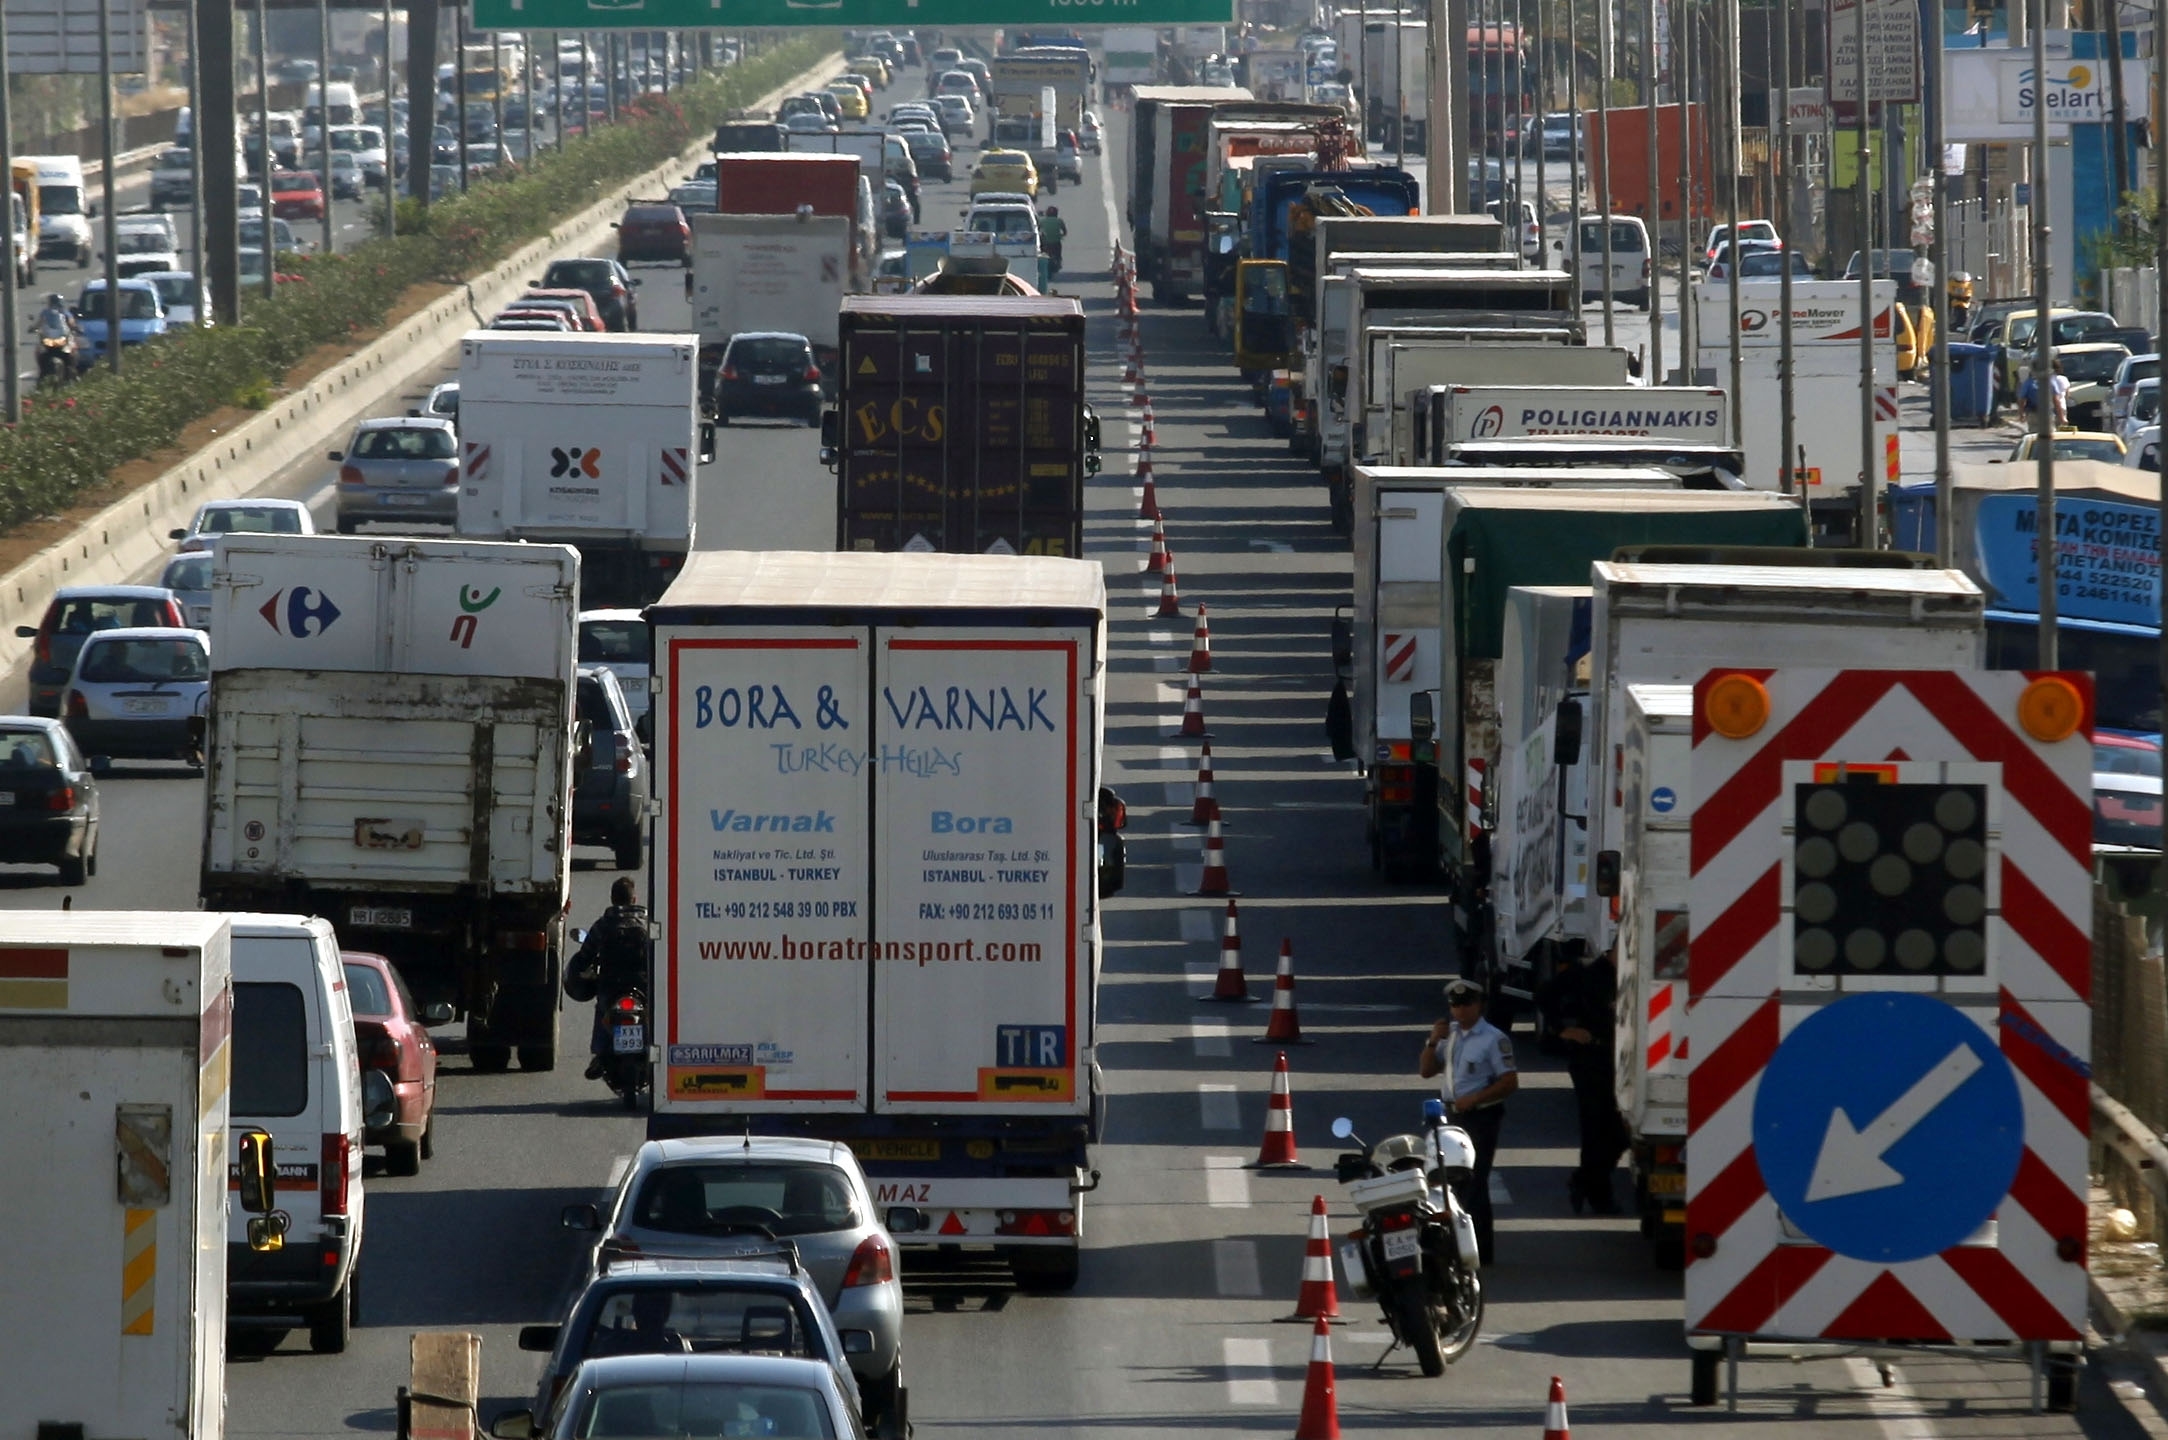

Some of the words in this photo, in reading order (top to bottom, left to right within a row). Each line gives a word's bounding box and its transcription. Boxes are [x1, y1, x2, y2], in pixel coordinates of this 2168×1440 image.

[2019, 88, 2102, 108] Selart
[856, 397, 947, 444] ECS
[1521, 409, 1719, 428] POLIGIANNAKIS
[2016, 510, 2081, 538] ΜΤΑ
[2083, 510, 2156, 533] ΦΟΡΕΣ
[2089, 573, 2153, 592] 522520
[696, 685, 802, 730] BORA
[816, 685, 850, 731] &
[883, 686, 1056, 733] VARNAK
[711, 809, 836, 833] Varnak
[931, 811, 1013, 834] Bora
[713, 849, 756, 863] Nakliyat
[759, 852, 771, 860] ve
[713, 868, 777, 882] ISTANBUL
[787, 867, 841, 881] TURKEY
[923, 869, 986, 883] ISTANBUL
[996, 869, 1049, 883] TURKEY
[696, 902, 722, 919] TEL:
[724, 902, 746, 918] +90
[749, 902, 770, 918] 212
[772, 902, 794, 918] 548
[797, 902, 812, 918] 39
[815, 901, 830, 918] 00
[832, 901, 858, 918] PBX
[919, 903, 946, 920] FAX:
[948, 903, 970, 919] +90
[973, 903, 995, 920] 212
[997, 903, 1020, 920] 693
[1022, 903, 1037, 920] 05
[1040, 903, 1054, 920] 11
[698, 933, 1042, 967] www.boratransport.com
[1002, 1029, 1058, 1066] TIR
[876, 1143, 936, 1156] VEHICLE
